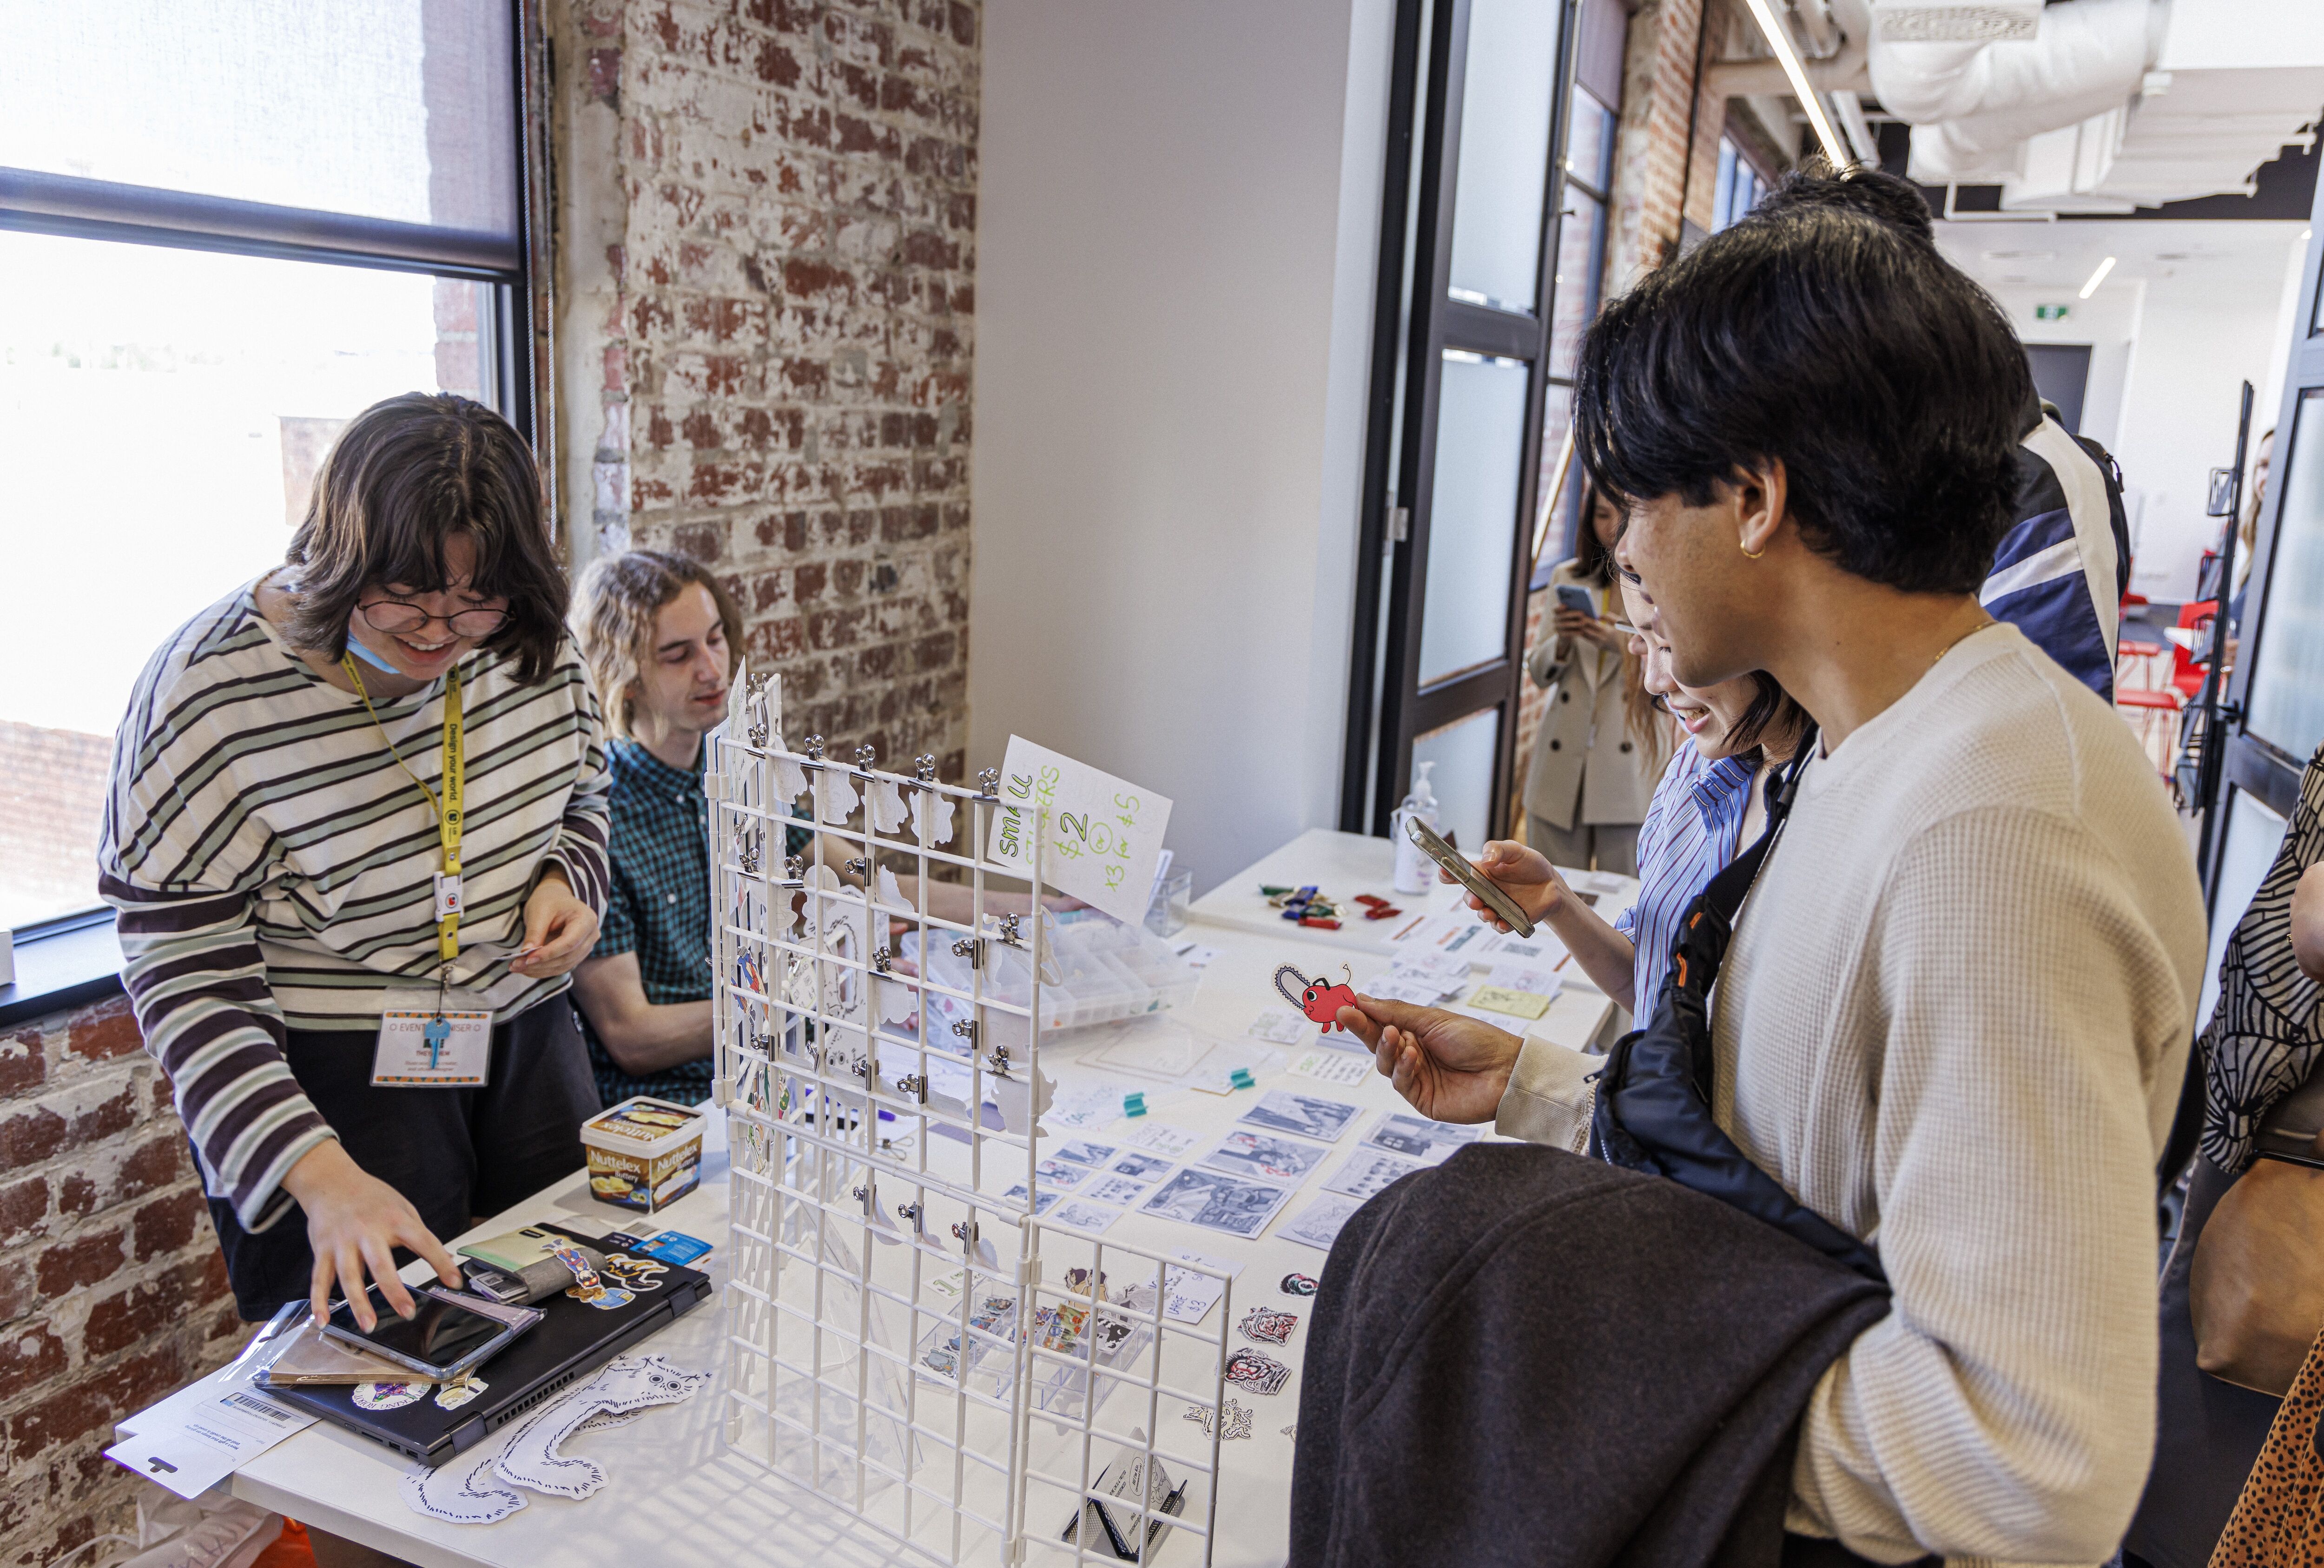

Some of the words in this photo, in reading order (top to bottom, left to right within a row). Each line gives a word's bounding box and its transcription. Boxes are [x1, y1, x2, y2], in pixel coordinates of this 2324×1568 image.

[448, 724, 457, 753] Design
[449, 776, 457, 802] world.
[1053, 812, 1088, 860] $2
[400, 1023, 425, 1032] EVENT
[591, 1149, 641, 1174] Nuttelex
[657, 1142, 698, 1173] Nuttelex
[676, 1156, 695, 1171] Buttery
[615, 1170, 639, 1184] Buttery
[1167, 1294, 1188, 1315] LARGE
[1187, 1299, 1206, 1312] $3
[354, 1395, 376, 1409] ROBOT
